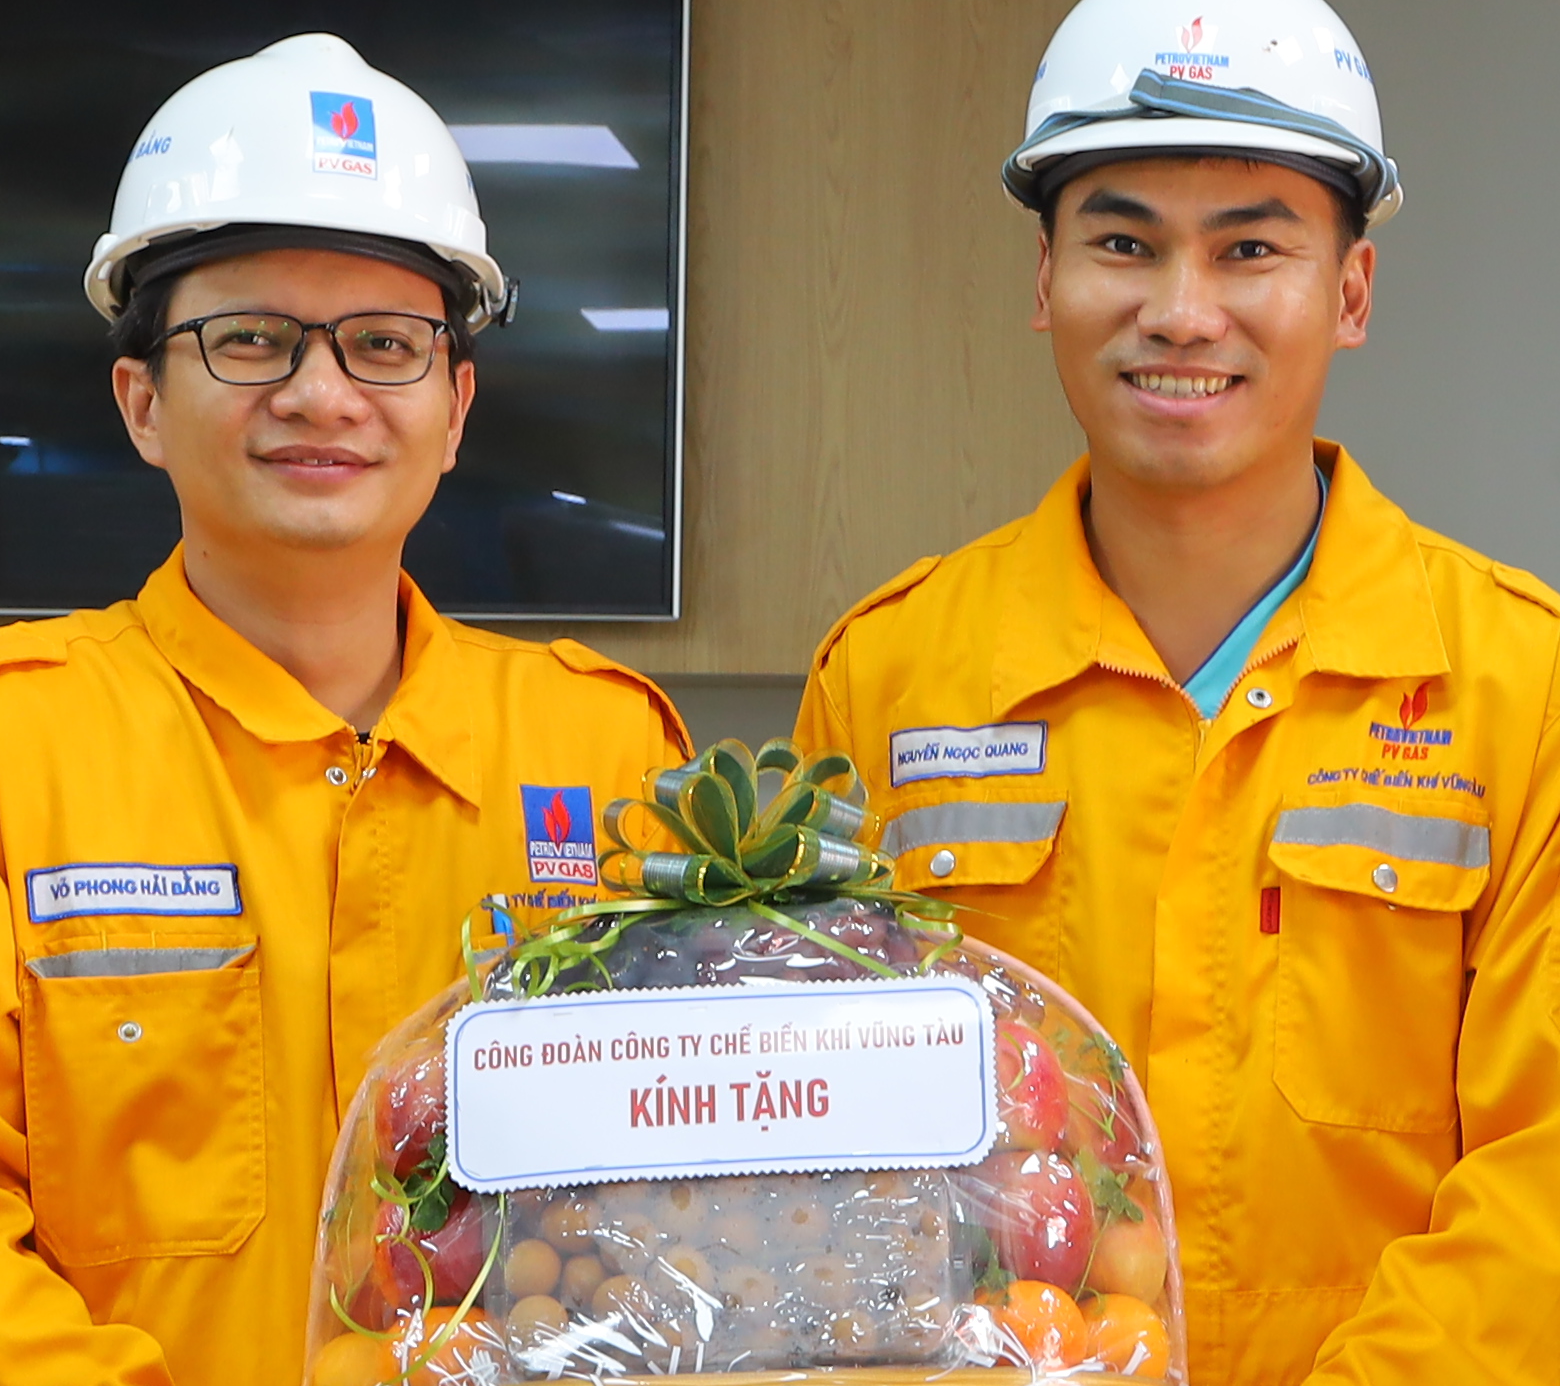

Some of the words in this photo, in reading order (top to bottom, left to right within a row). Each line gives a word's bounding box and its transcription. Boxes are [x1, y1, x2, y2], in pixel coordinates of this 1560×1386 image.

[1155, 52, 1230, 68] PETROVIETNAM
[1169, 66, 1185, 80] PV
[1189, 66, 1214, 80] GAS
[342, 159, 373, 175] GAS
[897, 742, 940, 766] NGUYỄN
[943, 746, 981, 762] NGỌC
[985, 742, 1029, 758] QUANG
[1382, 743, 1400, 761] PV
[1402, 746, 1430, 761] GAS
[1307, 768, 1341, 785] CÔNG
[1343, 768, 1359, 781] TY
[530, 841, 593, 858] PETROVIETNAM
[533, 861, 557, 875] PV
[74, 879, 138, 896] PHONG
[473, 1040, 534, 1072] CÔNG
[541, 1033, 603, 1065] ĐOÀN
[610, 1031, 671, 1062] CÔNG
[678, 1034, 703, 1058] TY
[710, 1023, 755, 1056] CHẾ
[759, 1021, 809, 1053] BIẾN
[815, 1026, 852, 1053] KHÍ
[857, 1019, 916, 1050] VŨNG
[922, 1017, 965, 1048] TÀU
[629, 1074, 718, 1129] KÍNH
[729, 1071, 830, 1132] TẶNG
